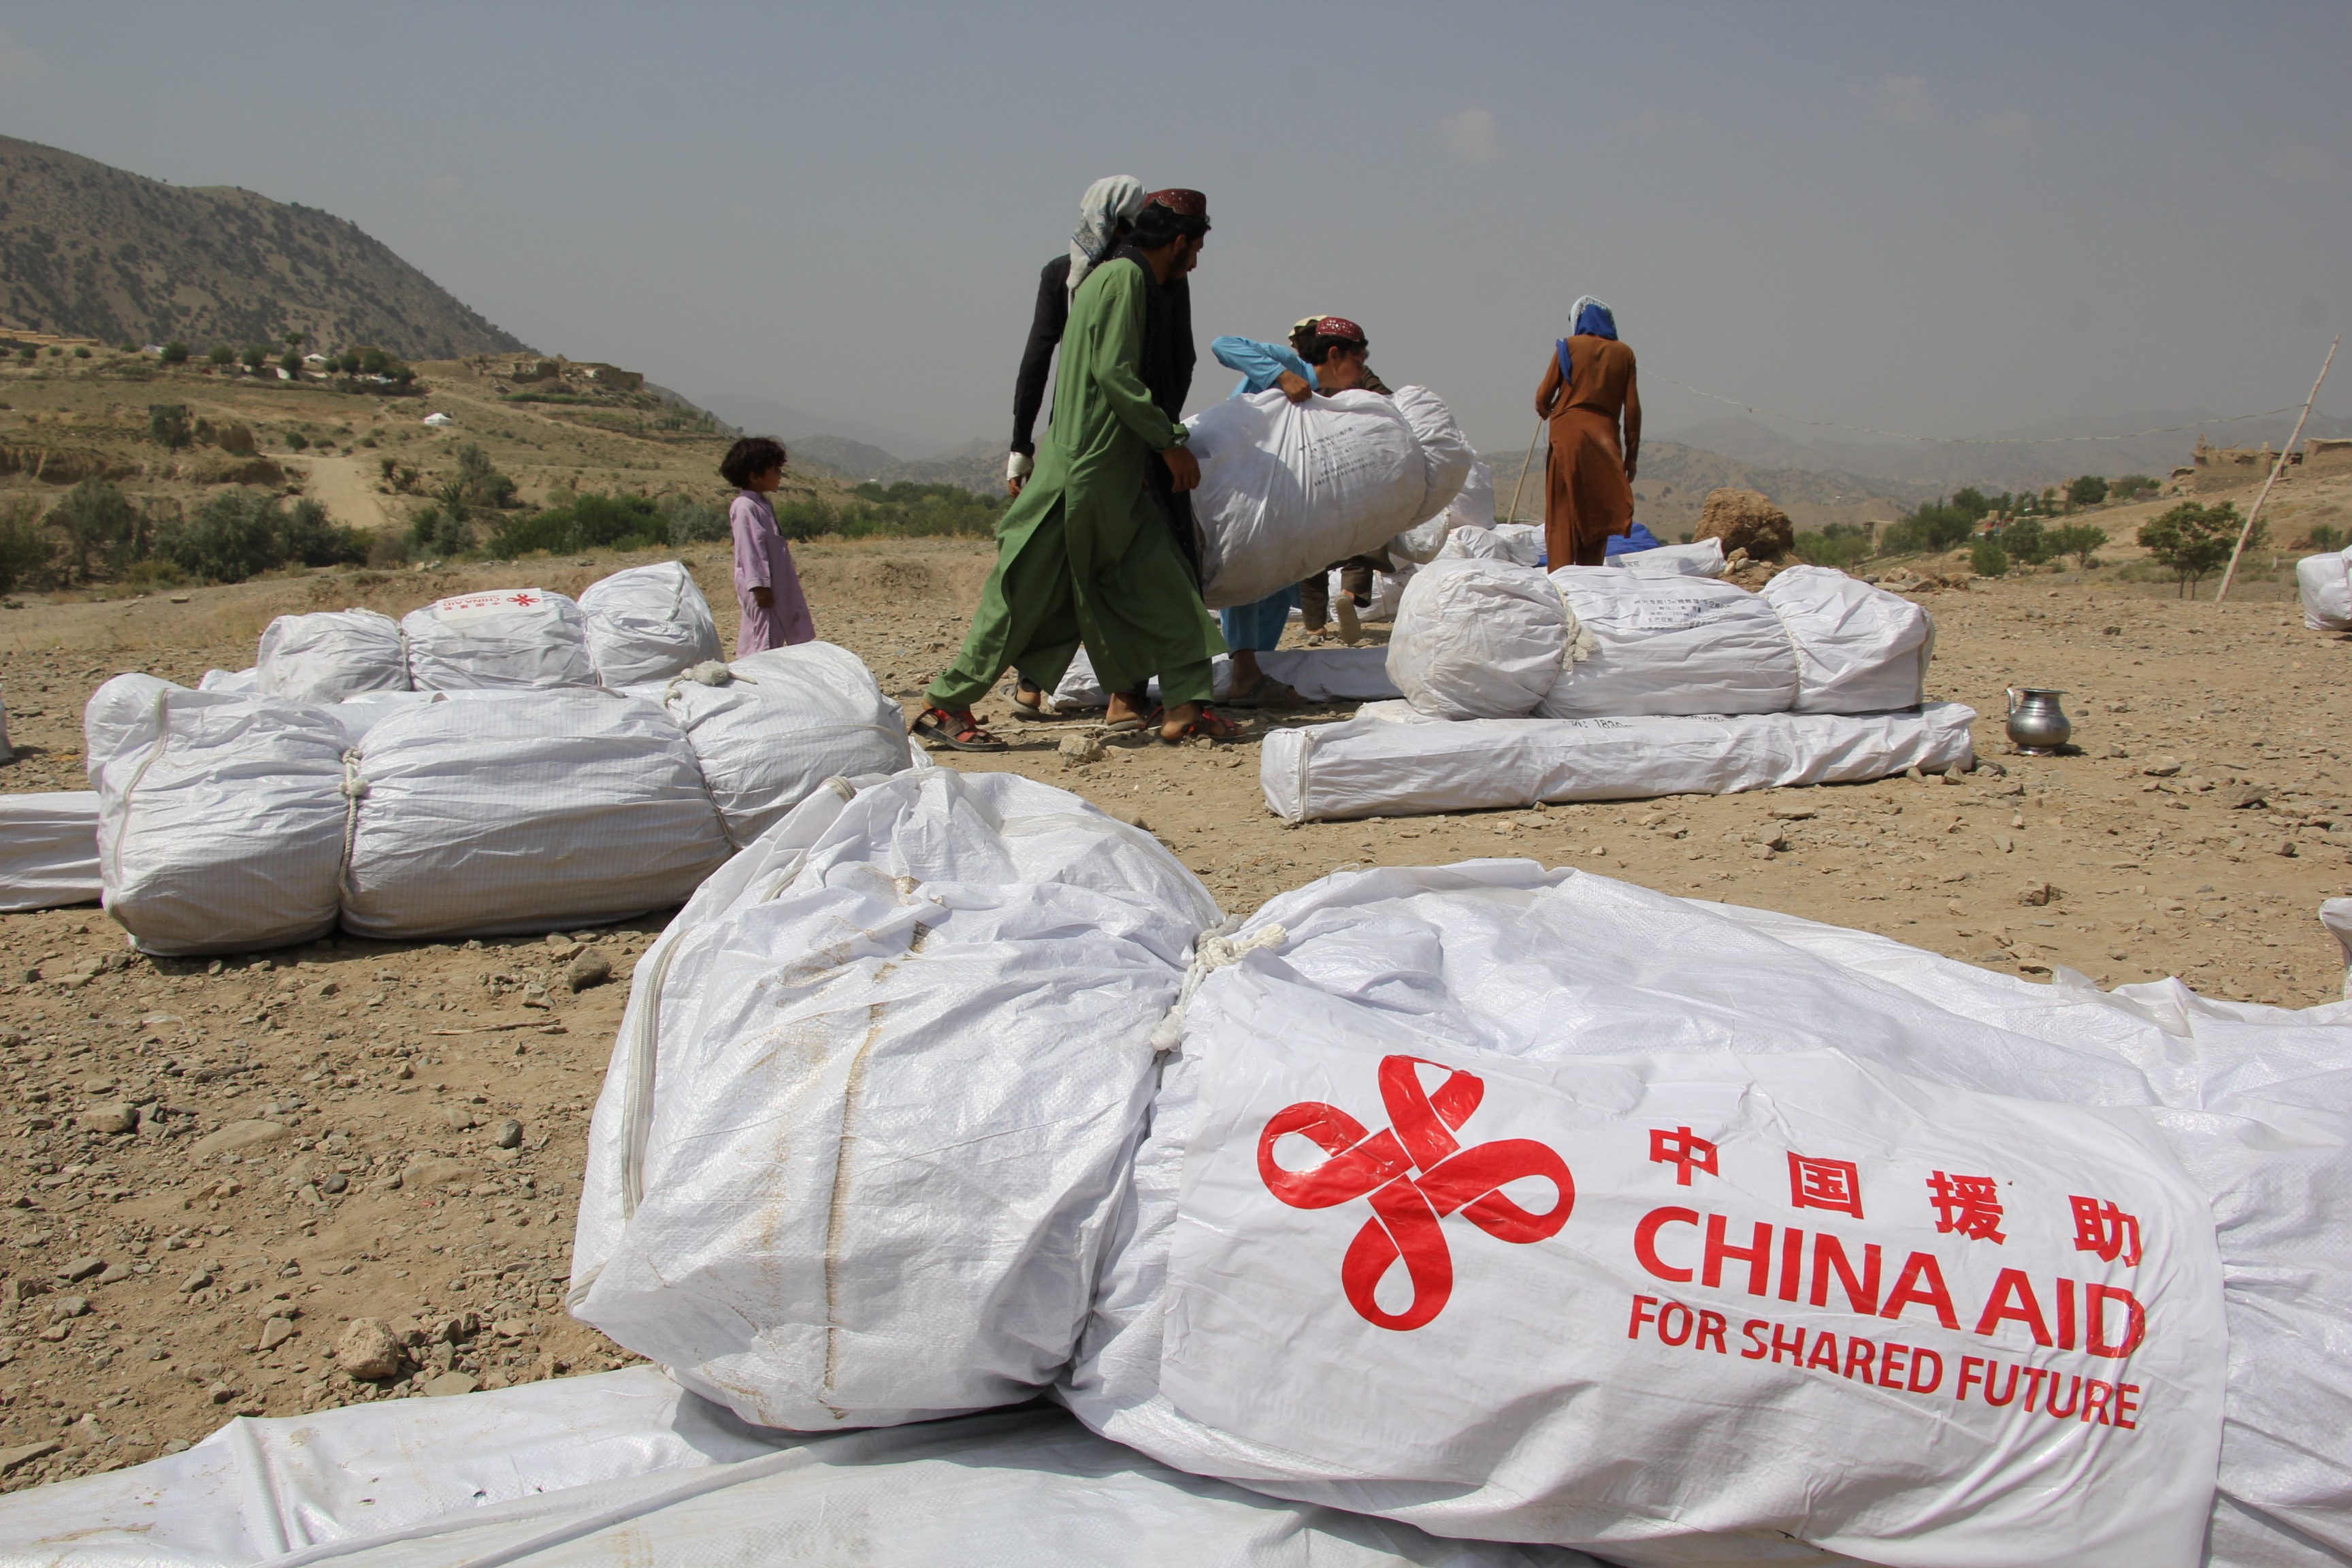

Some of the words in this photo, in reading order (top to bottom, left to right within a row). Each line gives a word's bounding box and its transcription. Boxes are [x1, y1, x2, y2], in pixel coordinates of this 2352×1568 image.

[1648, 1126, 2142, 1268] 中国援助
[1633, 1206, 1961, 1330] CHINA
[1974, 1267, 2145, 1359] AID
[1628, 1294, 1727, 1354] FOR
[1740, 1318, 1943, 1394] SHARED
[1956, 1355, 2140, 1430] FUTURE
